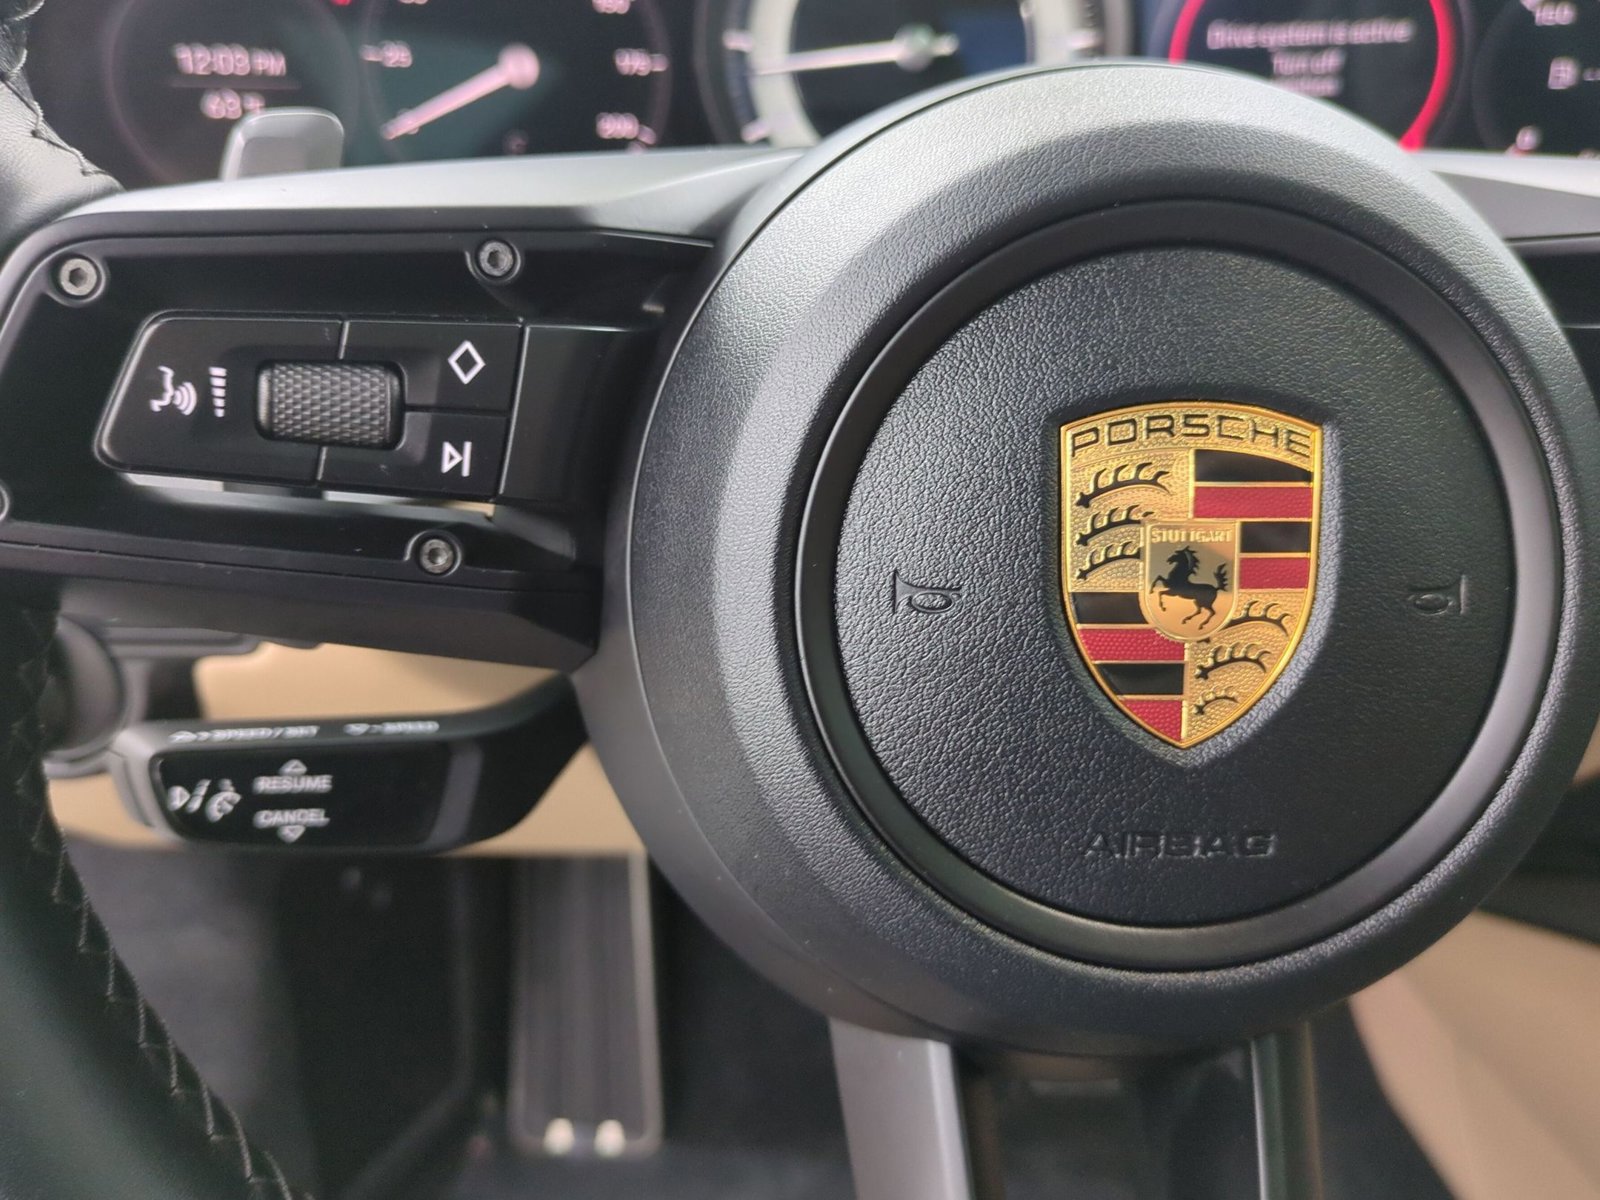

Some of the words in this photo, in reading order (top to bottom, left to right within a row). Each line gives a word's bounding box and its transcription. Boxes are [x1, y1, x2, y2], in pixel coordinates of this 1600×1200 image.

[250, 48, 286, 76] PM
[1070, 413, 1311, 458] PORSCHE
[1150, 528, 1233, 543] STUTTGART
[253, 774, 333, 793] RESUME
[253, 808, 331, 829] CANCEL
[1084, 832, 1277, 859] AIRBAG
